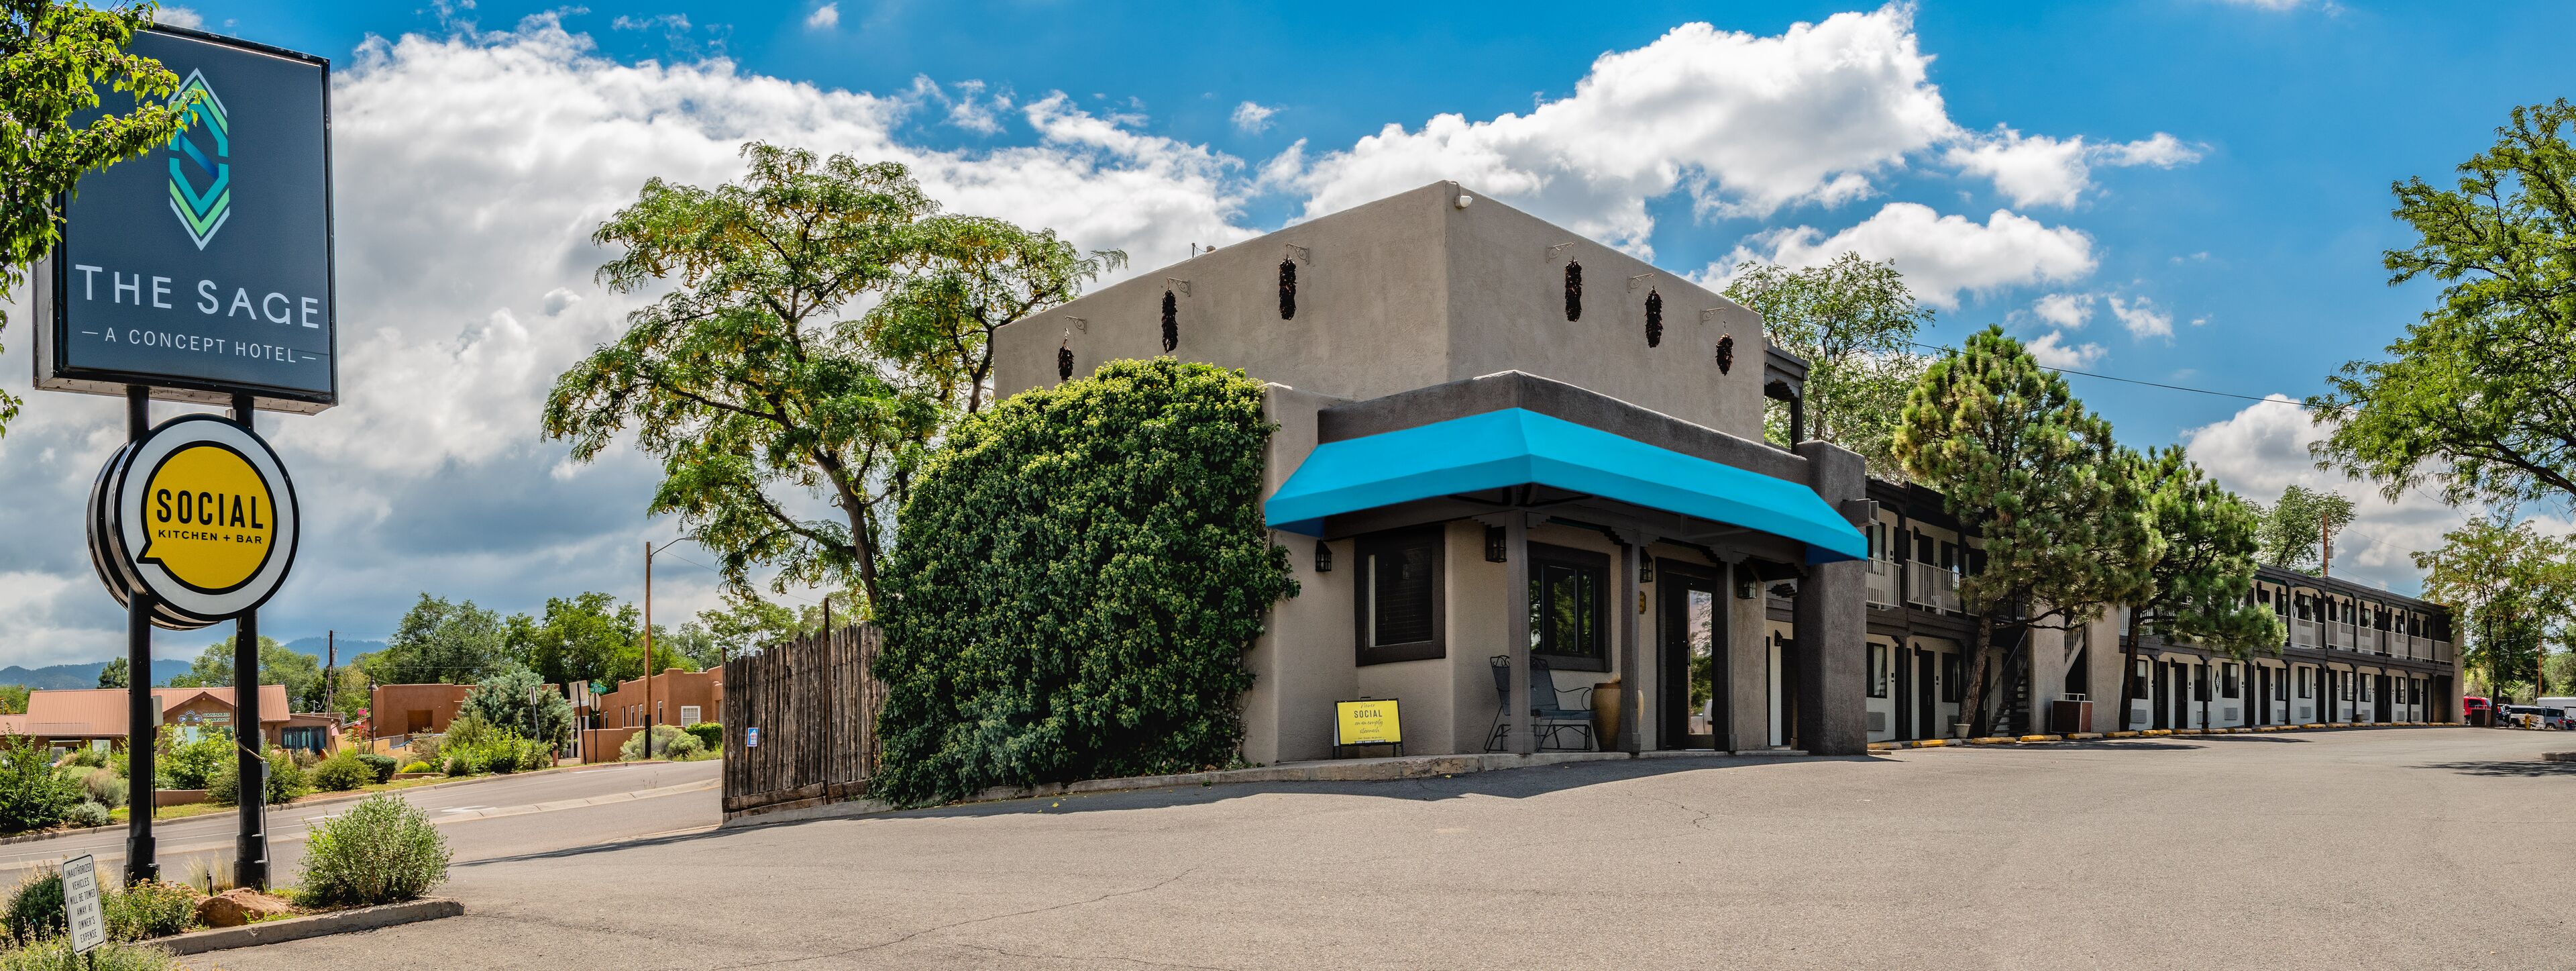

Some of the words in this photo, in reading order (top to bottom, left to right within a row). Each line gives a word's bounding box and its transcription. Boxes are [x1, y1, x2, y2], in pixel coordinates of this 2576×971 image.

[76, 264, 172, 309] THE
[197, 280, 319, 329] SAGE
[105, 327, 117, 342] A
[129, 329, 225, 354] CONCEPT
[235, 342, 296, 363] HOTEL
[156, 489, 264, 529] SOCIAL
[158, 529, 217, 541] KITCHEN
[236, 535, 262, 544] BAR
[1354, 709, 1383, 718] SOCIAL
[66, 863, 92, 878] UNAUTHORIZED
[72, 877, 89, 890] VEHICLES
[70, 895, 78, 905] WILL
[78, 892, 84, 902] BE
[84, 888, 95, 900] TOWED
[77, 905, 87, 917] AWAY
[88, 903, 93, 912] AT
[78, 916, 95, 930] OWNER'S
[80, 929, 97, 943] EXPENSE
